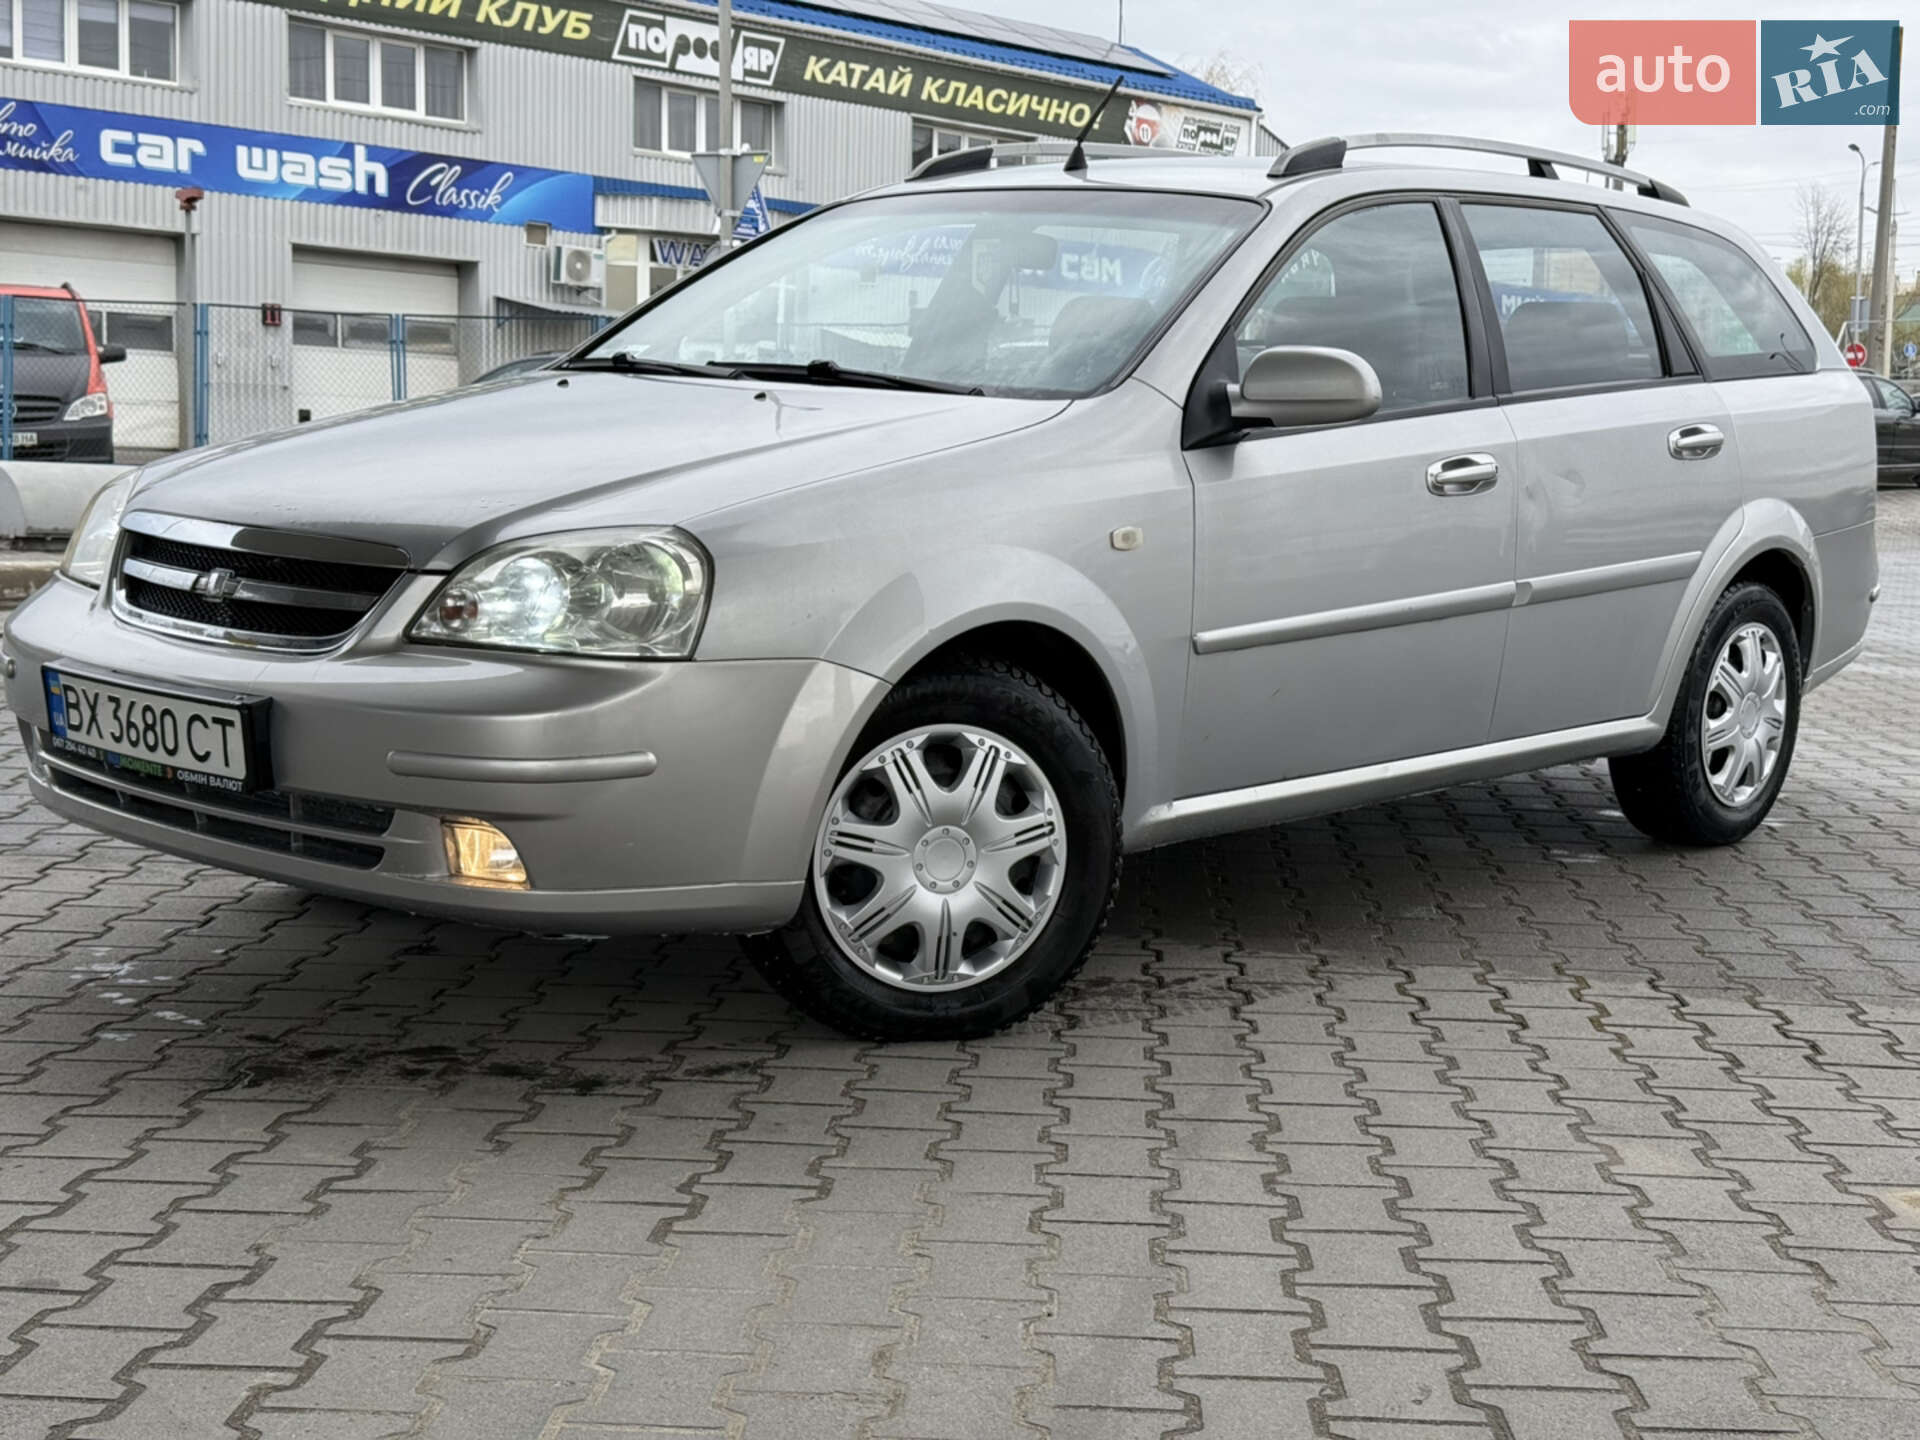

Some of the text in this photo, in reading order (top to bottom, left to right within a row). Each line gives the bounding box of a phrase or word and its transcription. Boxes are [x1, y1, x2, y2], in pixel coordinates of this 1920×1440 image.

[475, 0, 593, 40] КЛУБ
[803, 55, 914, 98] КАТАЙ
[100, 128, 389, 197] car wash
[406, 162, 514, 213] Classik
[106, 694, 179, 757] 3680
[176, 769, 243, 792] ОБМІН ВАЛЮТ
